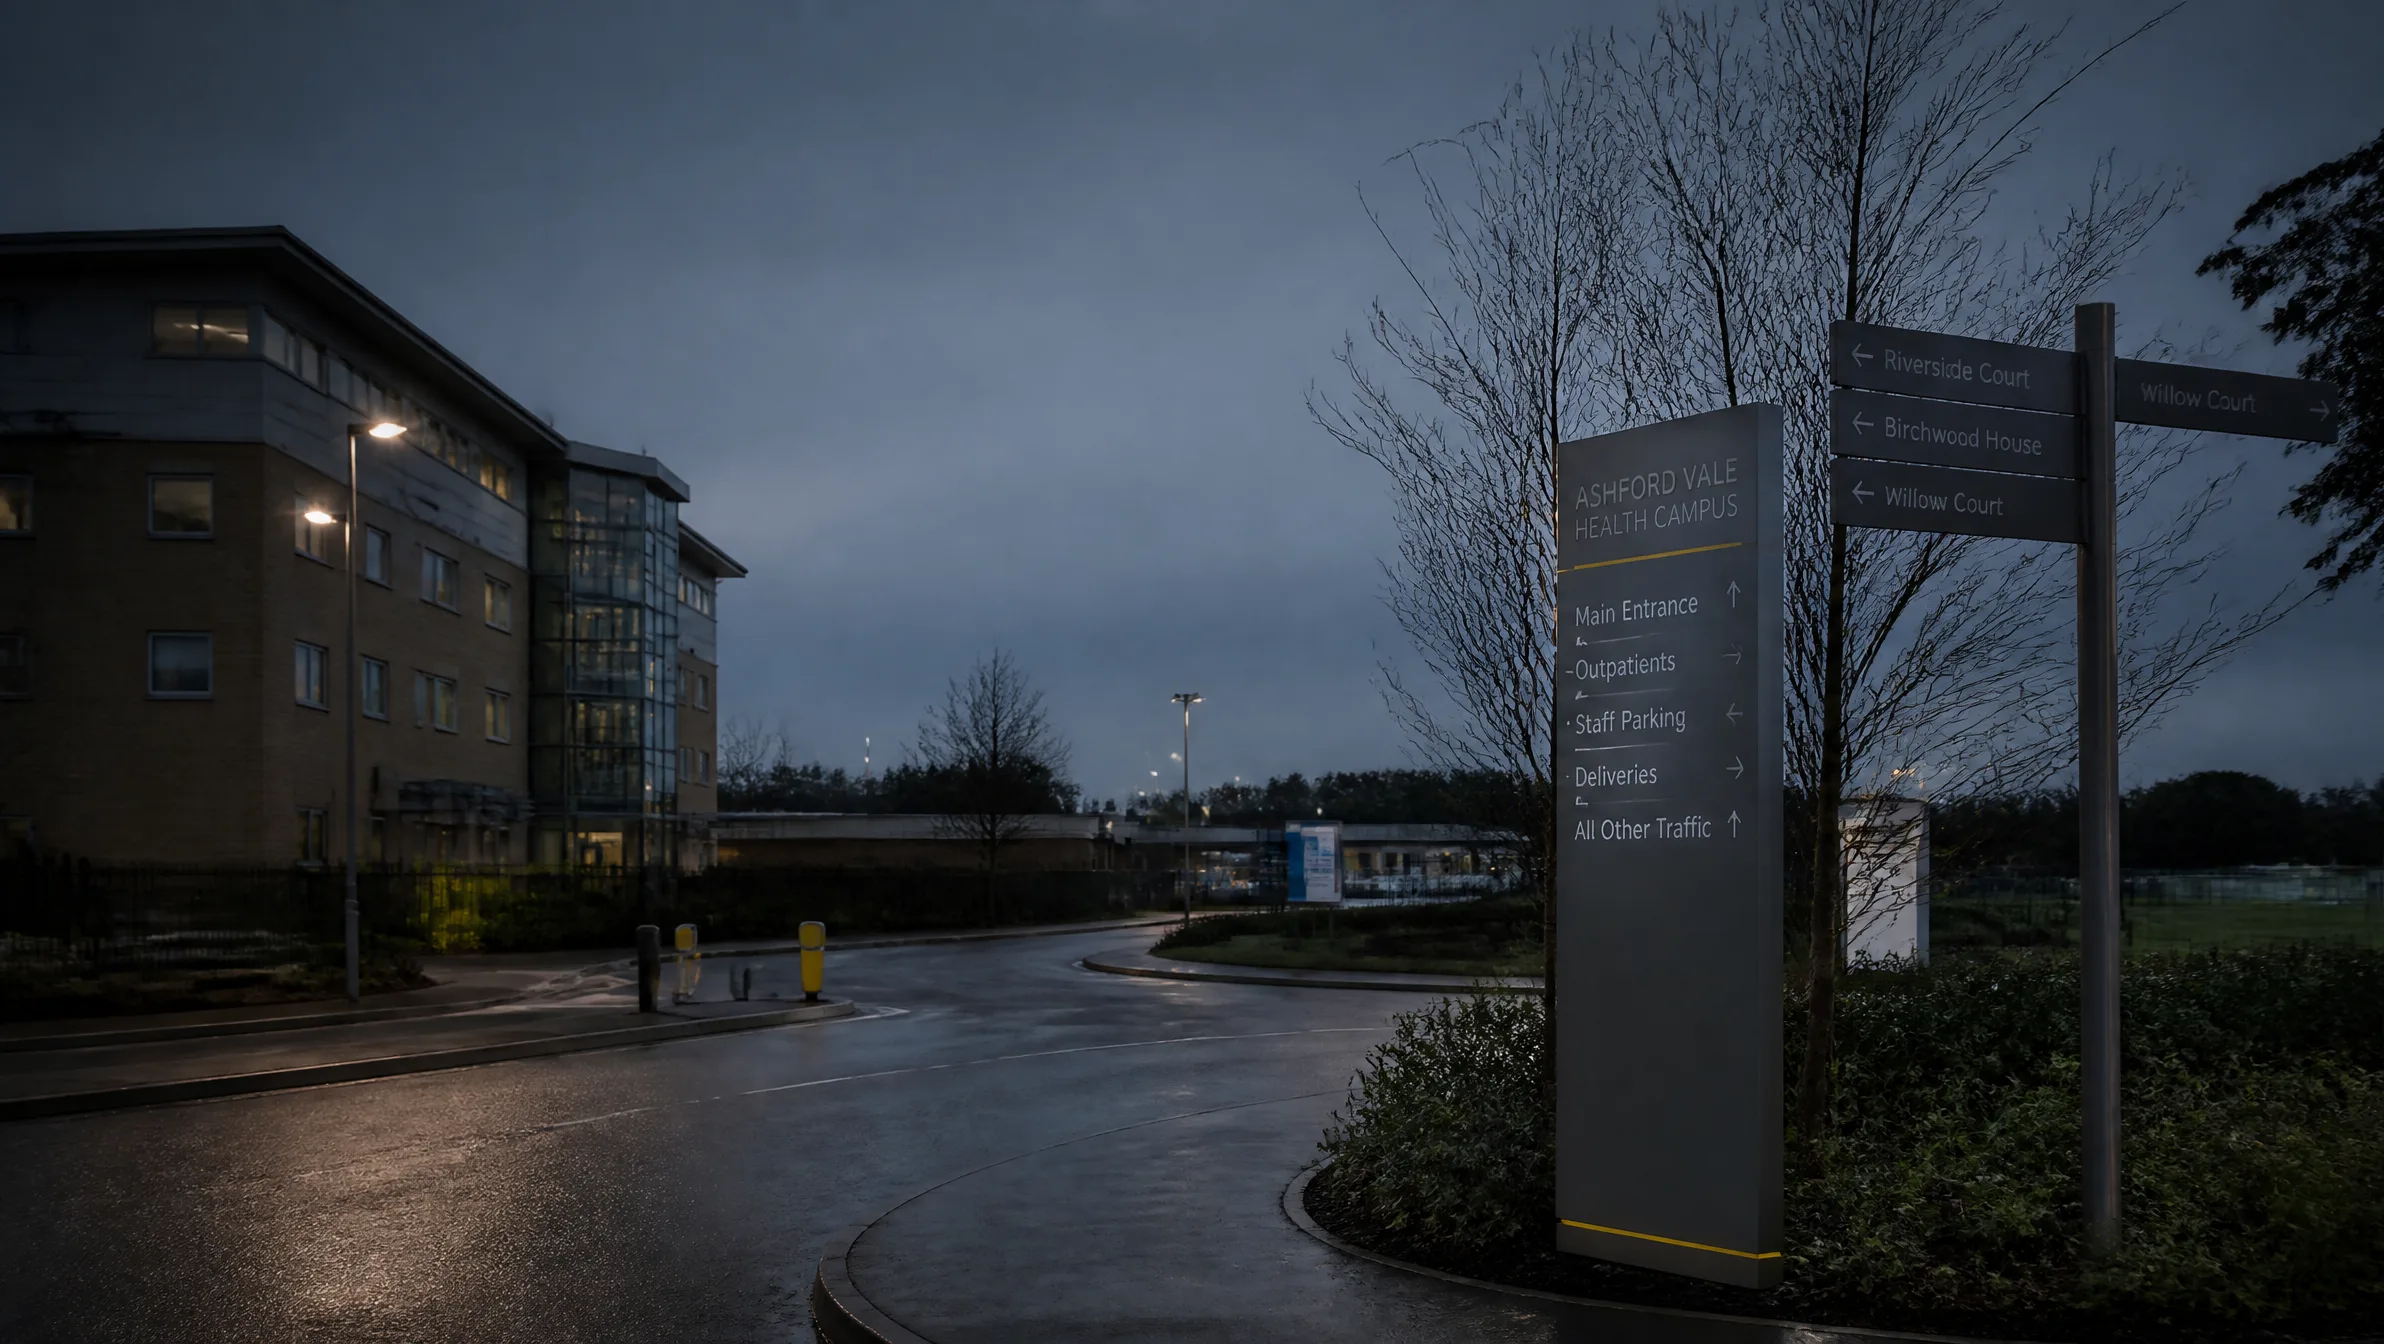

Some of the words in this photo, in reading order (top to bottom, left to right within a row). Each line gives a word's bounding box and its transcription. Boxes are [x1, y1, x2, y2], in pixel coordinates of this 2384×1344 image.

[1979, 362, 2030, 389] Court
[2140, 382, 2202, 408] Willow
[2207, 389, 2257, 413] Court
[1885, 416, 1979, 448] Birchwood
[1986, 430, 2042, 456] House
[1575, 469, 1676, 510] ASHFORD
[1683, 457, 1738, 491] VALE
[1885, 485, 1948, 511] Willow
[1953, 492, 2004, 516] Court
[1575, 508, 1647, 540] HEALTH
[1654, 493, 1738, 528] CAMPUS
[1575, 603, 1616, 627] Main
[1622, 596, 1699, 621] Entrance
[1575, 653, 1676, 683] Outpatients
[1575, 710, 1616, 735] Staff
[1621, 707, 1687, 733] Parking
[1575, 763, 1658, 788] Deliveries
[1574, 819, 1596, 841] All
[1600, 819, 1651, 841] Other
[1656, 815, 1712, 839] Traffic
